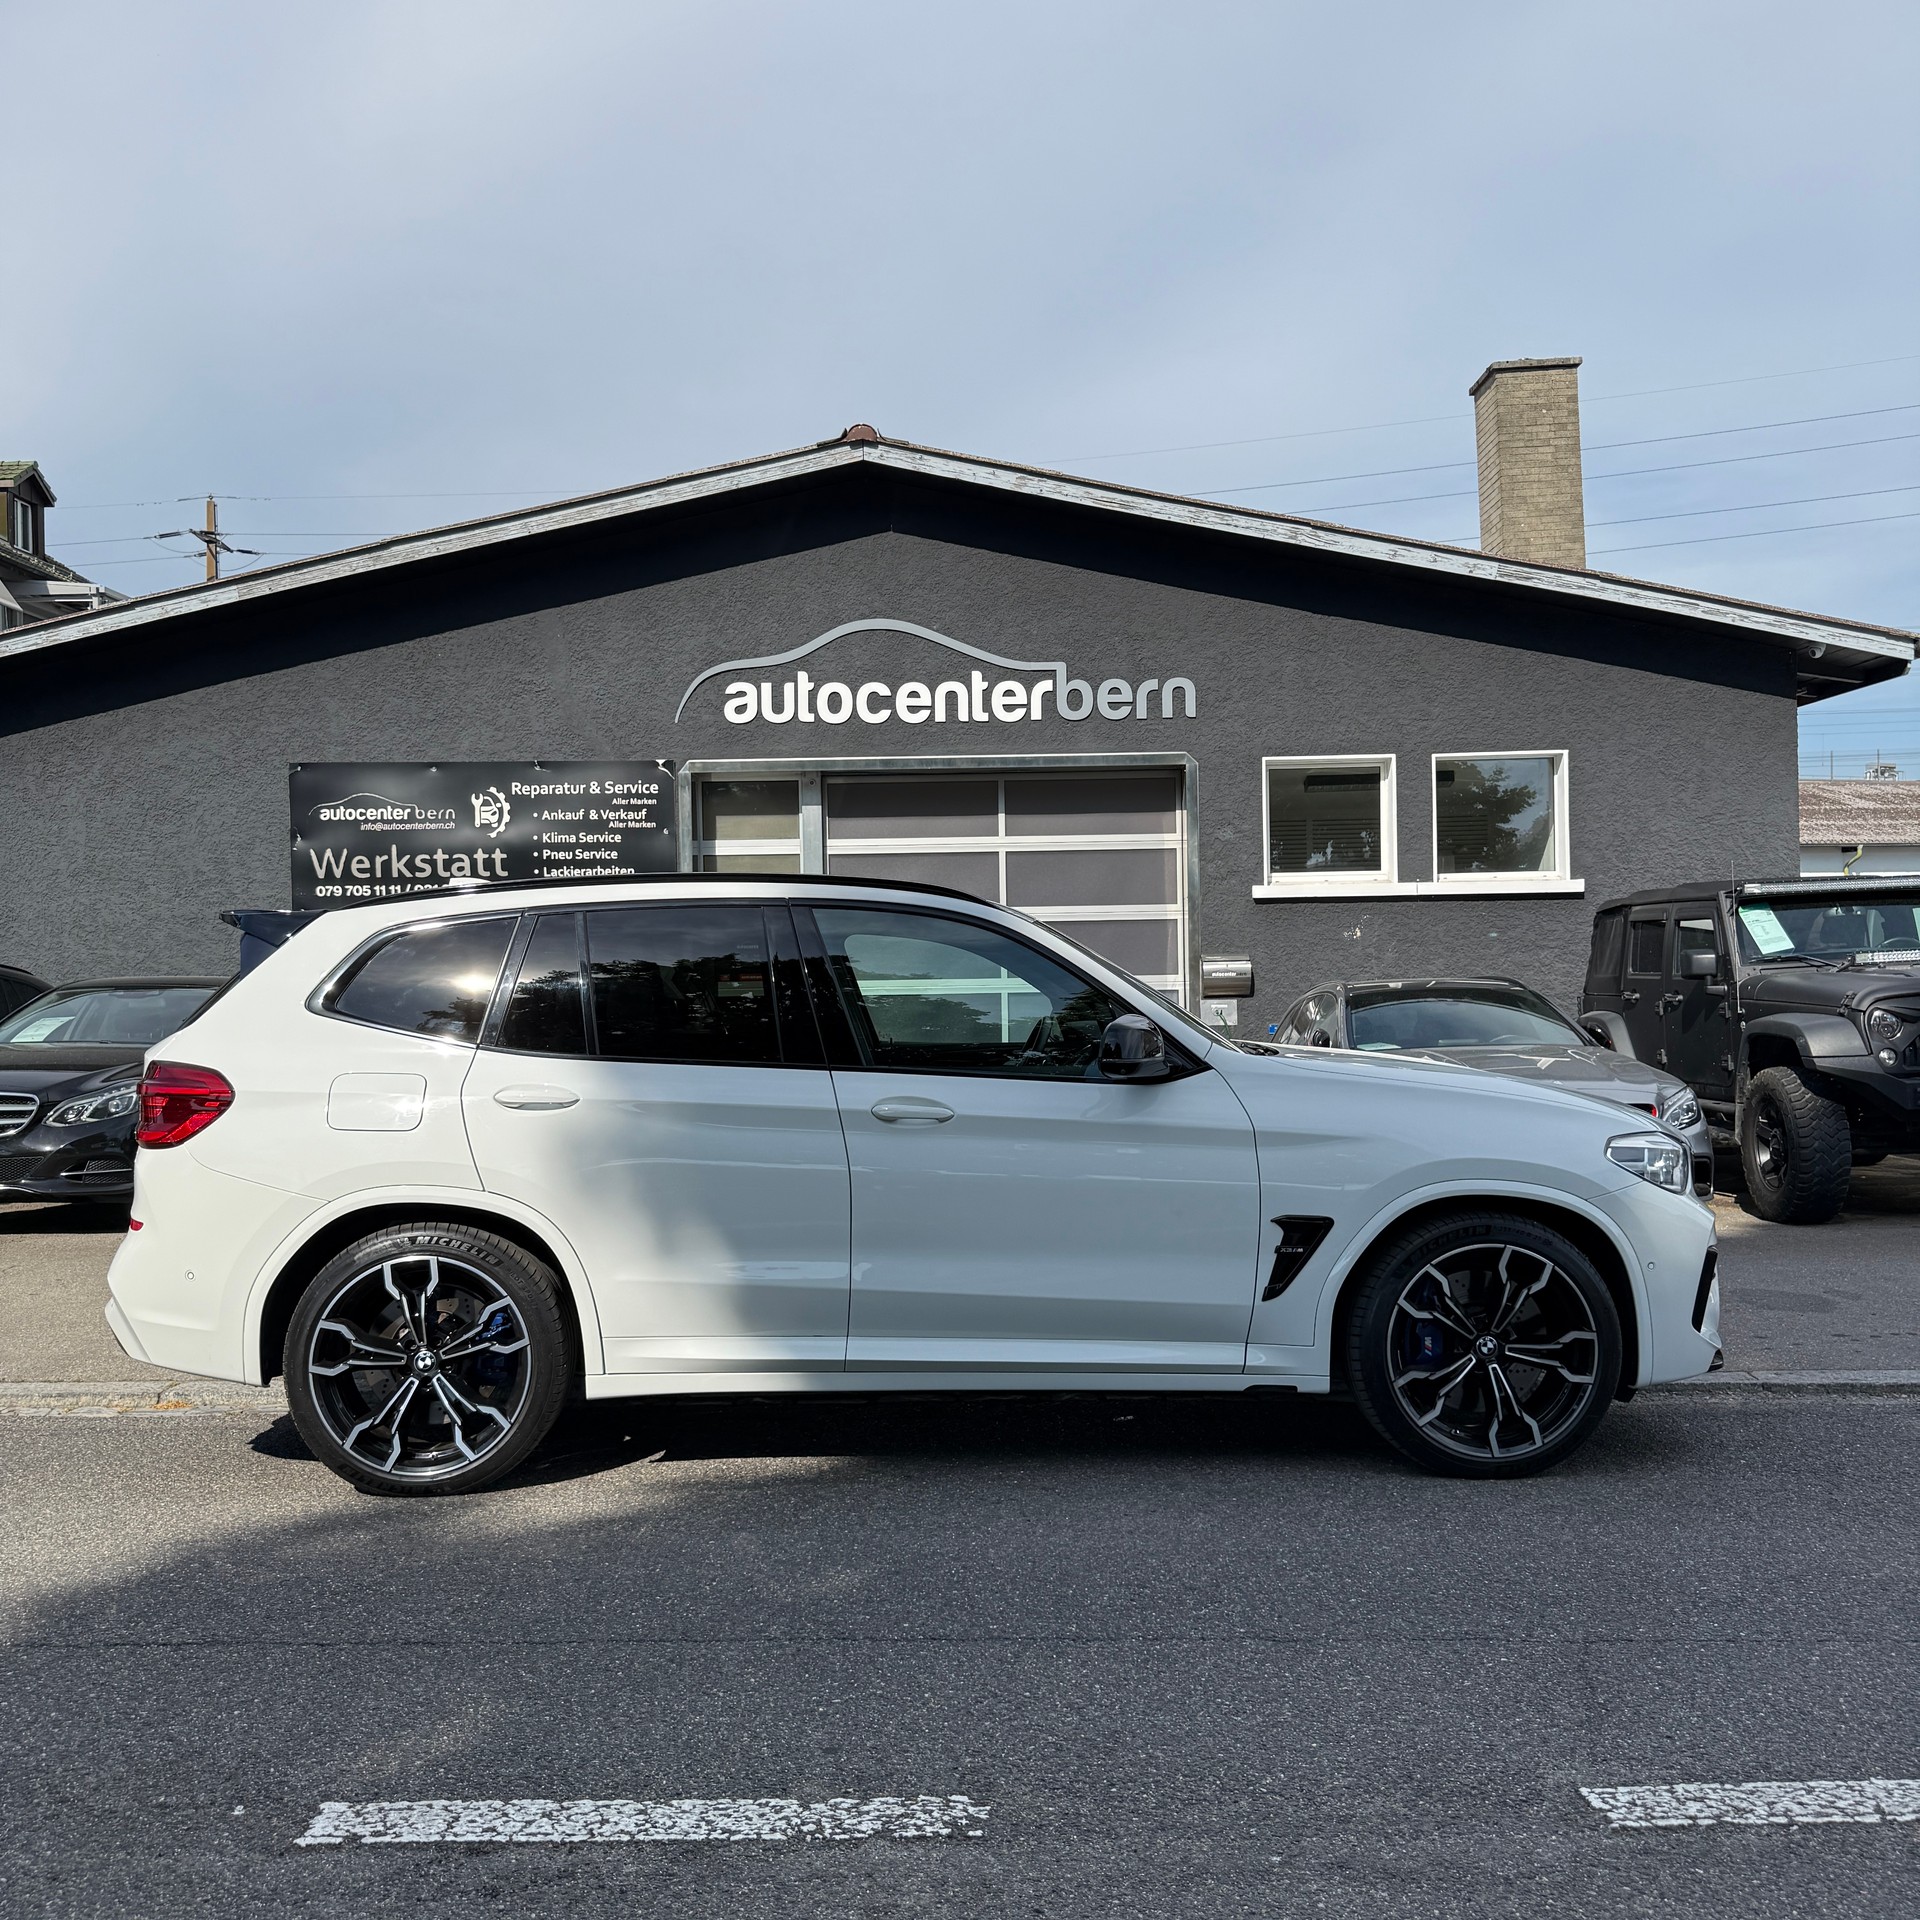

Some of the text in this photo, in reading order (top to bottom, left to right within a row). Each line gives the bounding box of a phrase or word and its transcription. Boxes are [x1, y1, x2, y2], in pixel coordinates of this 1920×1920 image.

[511, 779, 659, 799] Reparatur & Service
[611, 797, 658, 805] Aller Marken
[541, 808, 648, 821] Ankauf & Verkauf
[360, 821, 456, 831] info@autocenterbern.ch
[608, 820, 657, 829] Aller Marken
[542, 831, 622, 844] Klima Service
[542, 847, 619, 860] Pneu Service
[310, 843, 509, 879] Werkstatt
[543, 865, 636, 877] Lackierarbeiten
[315, 885, 343, 897] 079
[344, 884, 372, 897] 705
[373, 884, 387, 896] 11
[388, 884, 402, 896] 11
[415, 1236, 500, 1265] MICHELIN
